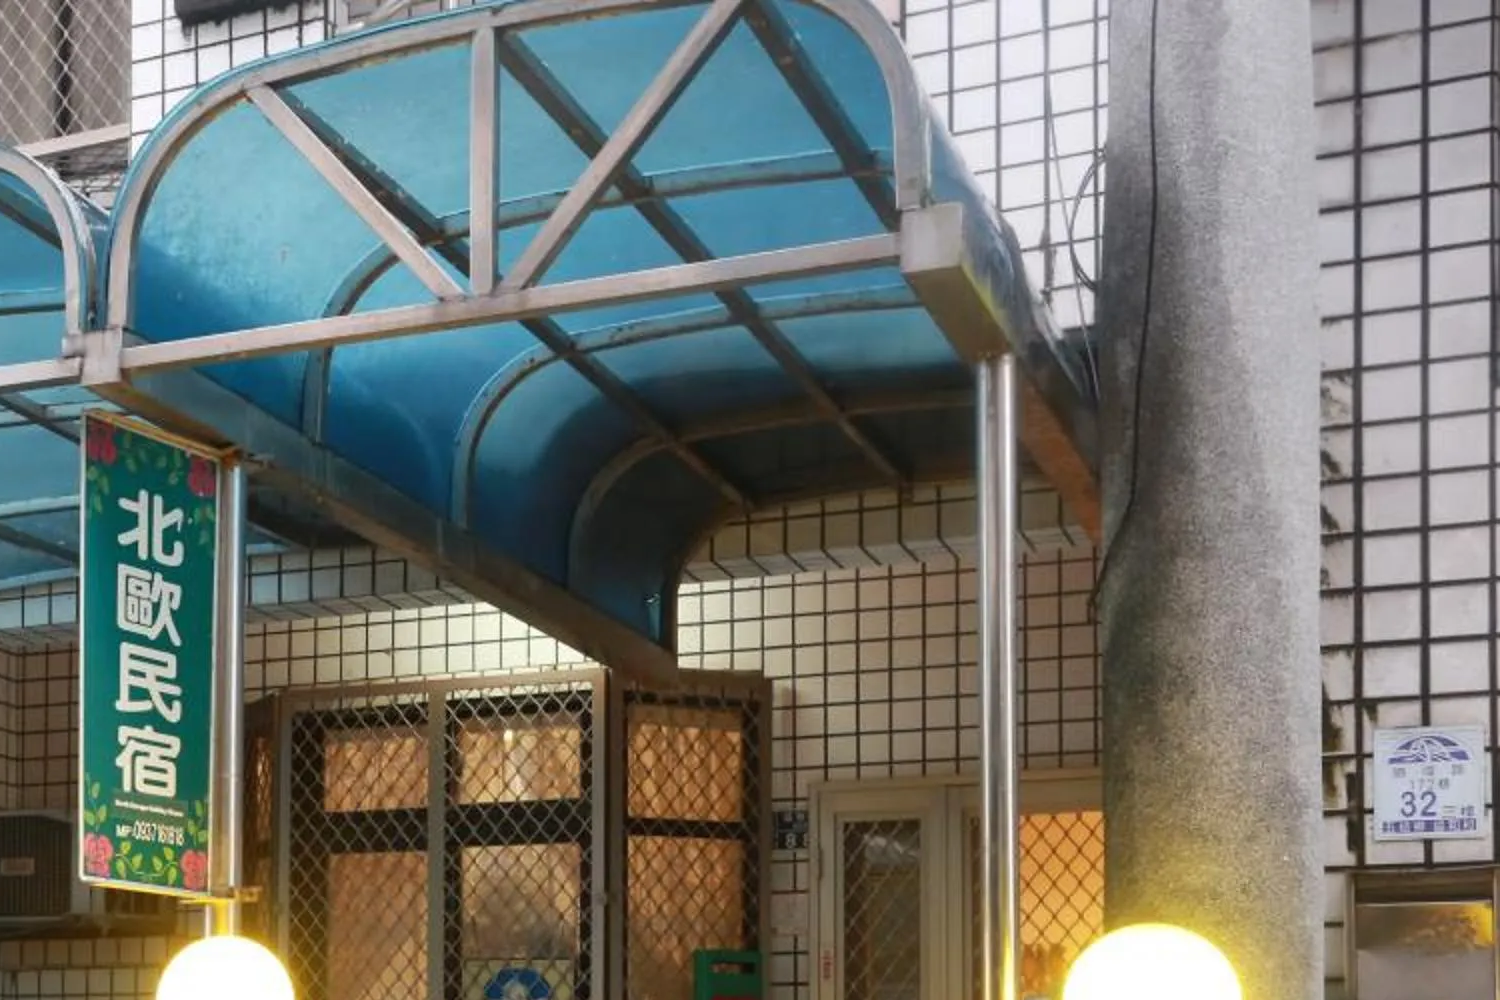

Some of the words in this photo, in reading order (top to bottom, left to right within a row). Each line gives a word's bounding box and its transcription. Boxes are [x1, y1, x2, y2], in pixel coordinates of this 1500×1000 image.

[115, 488, 185, 798] 北歐民宿
[1400, 791, 1437, 818] 32
